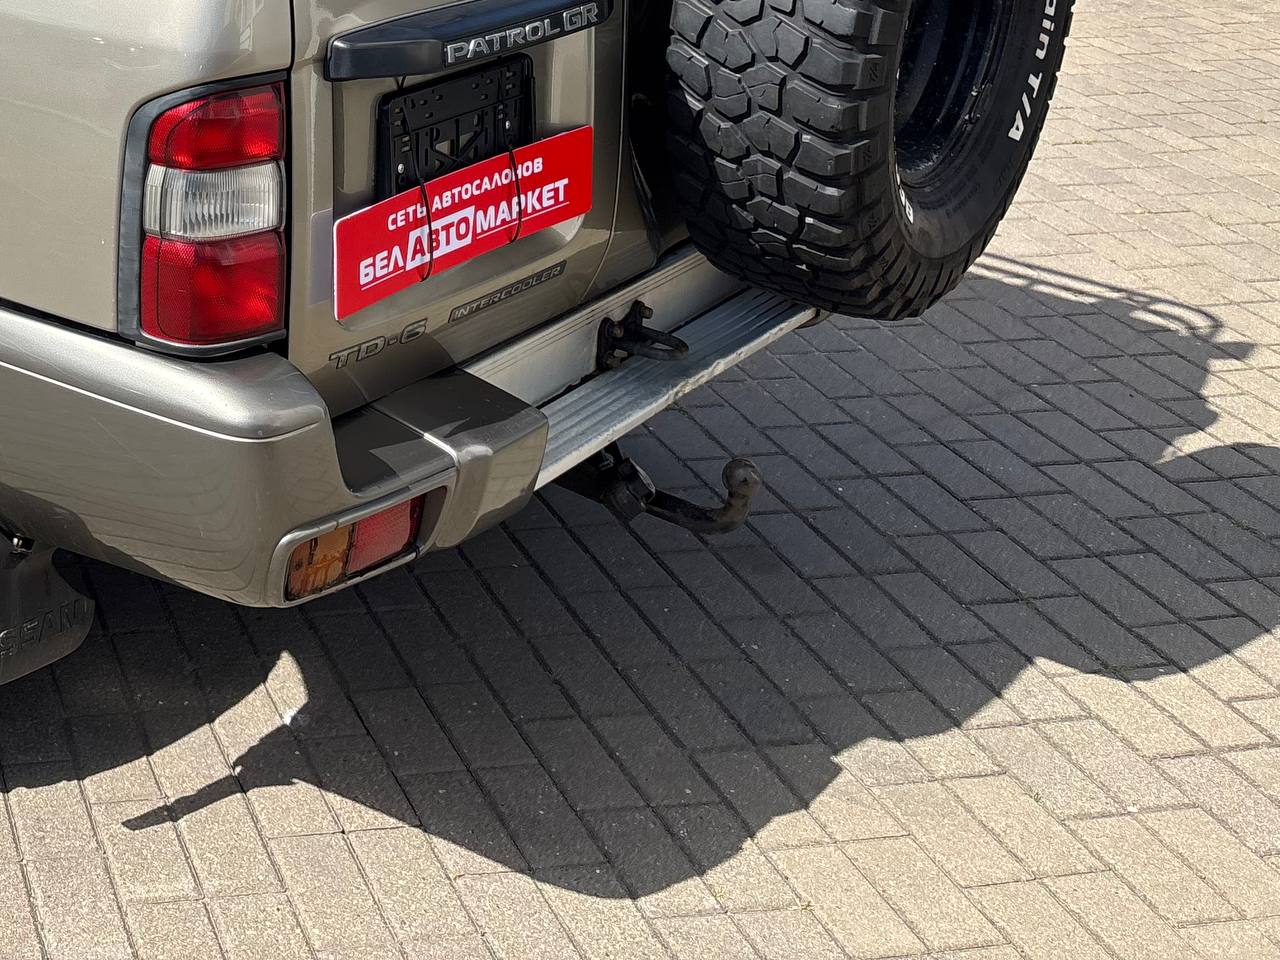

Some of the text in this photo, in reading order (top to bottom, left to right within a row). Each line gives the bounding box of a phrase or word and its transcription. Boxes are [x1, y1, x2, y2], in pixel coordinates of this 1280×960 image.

[446, 2, 599, 64] PATROL GR
[1007, 71, 1042, 142] T/A
[387, 157, 543, 231] СЕТЬ АВТОСАЛОНОВ
[451, 265, 562, 323] INTERCOOLER
